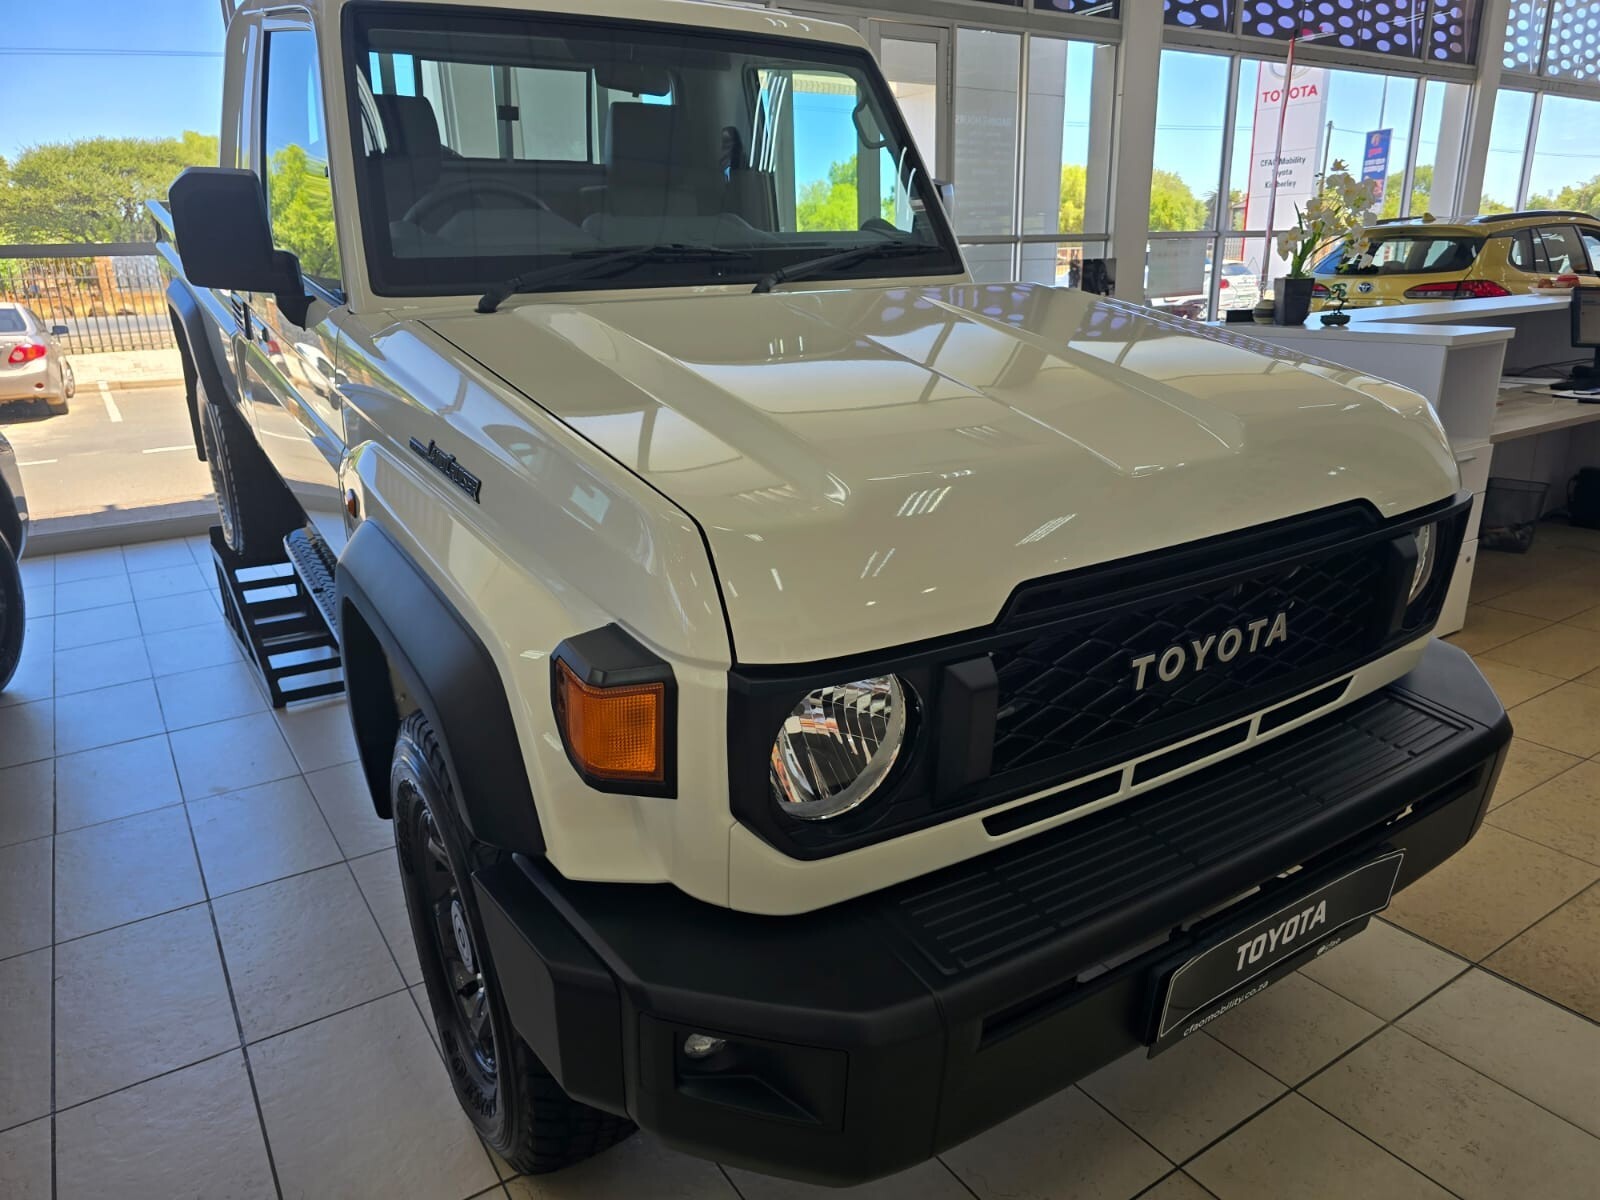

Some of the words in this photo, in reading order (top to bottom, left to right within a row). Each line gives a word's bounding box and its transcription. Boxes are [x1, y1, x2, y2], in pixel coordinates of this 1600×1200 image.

[1262, 84, 1318, 103] TOOTA
[1279, 156, 1306, 165] Mobility
[1132, 612, 1288, 691] TOYOTA
[1236, 899, 1326, 972] TOYOTA
[1183, 981, 1269, 1037] cfaomobility.co.za
